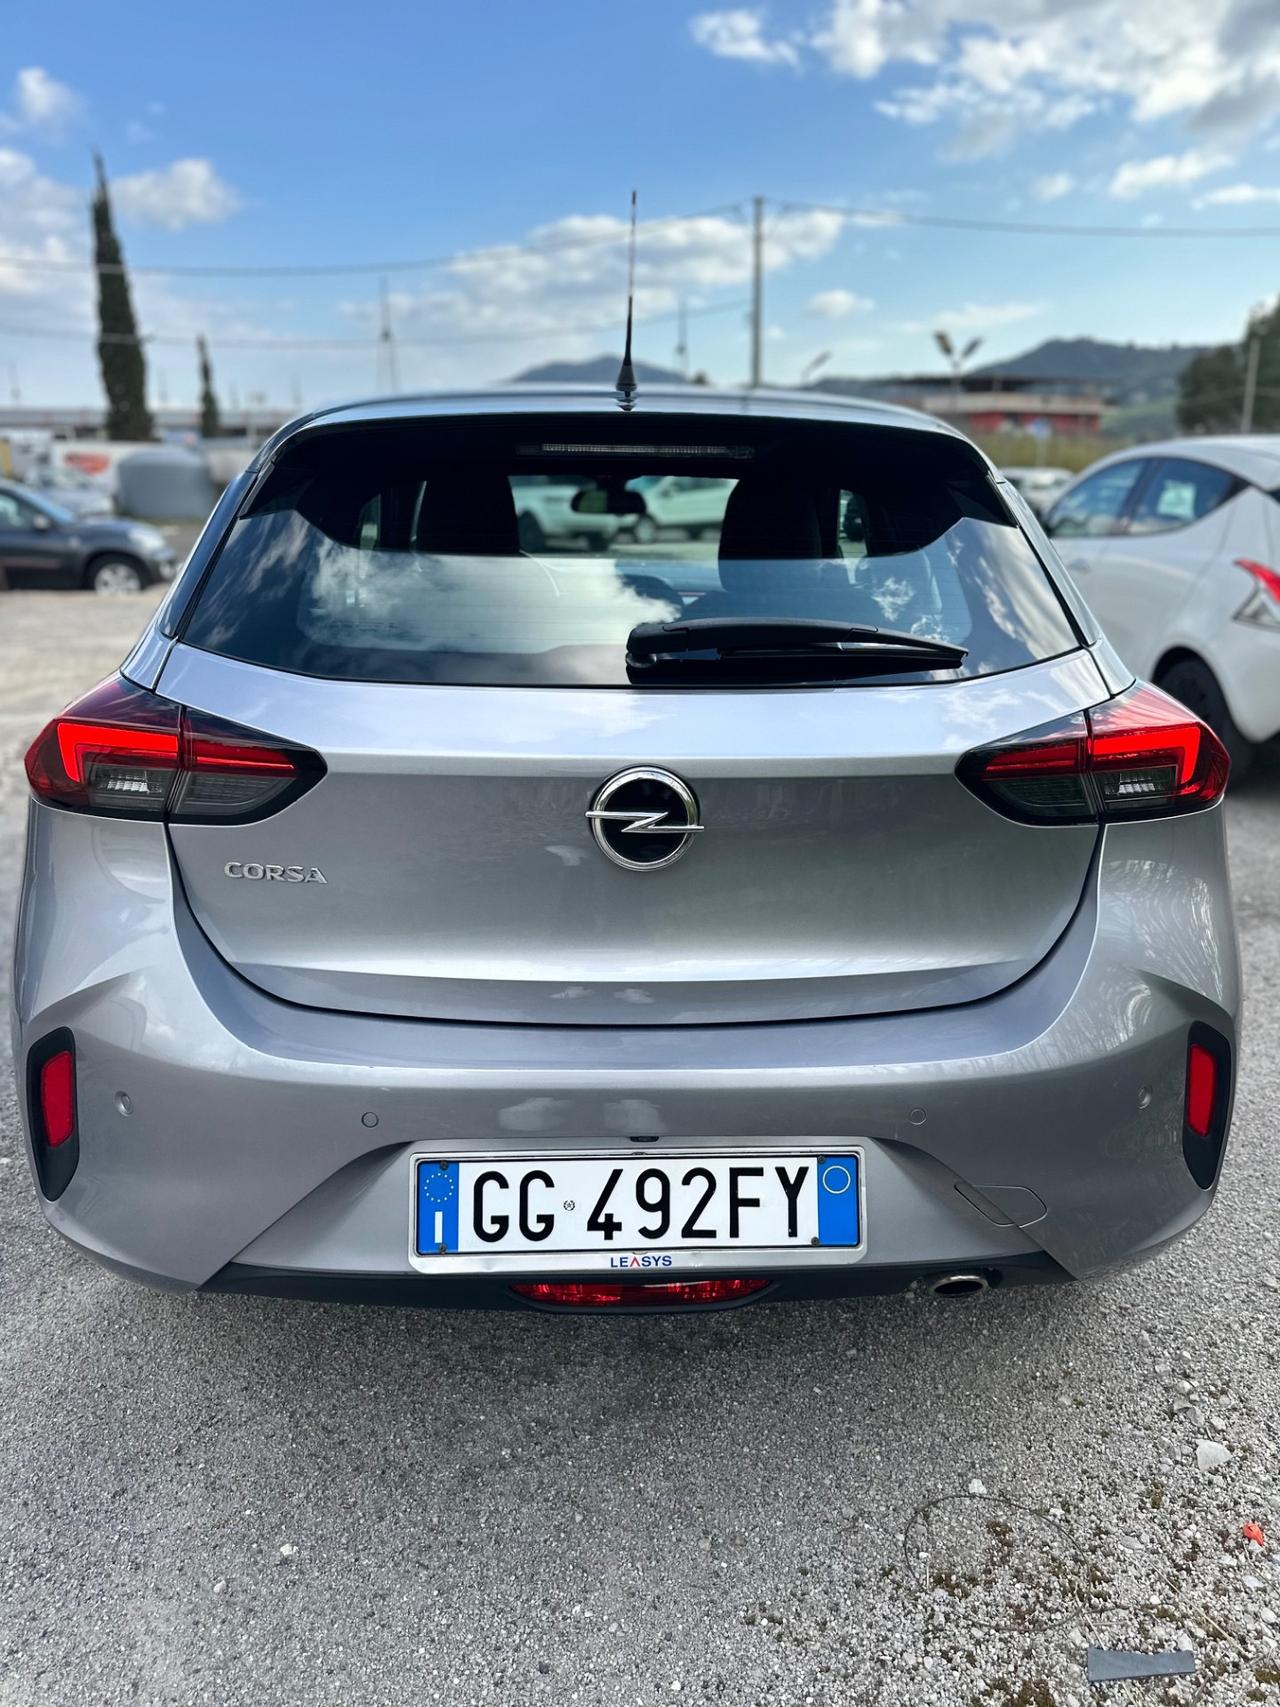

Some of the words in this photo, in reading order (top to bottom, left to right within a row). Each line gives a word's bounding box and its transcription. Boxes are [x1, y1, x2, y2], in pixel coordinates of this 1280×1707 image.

[224, 861, 328, 884] CORSA
[472, 1169, 555, 1243] GG
[586, 1166, 810, 1241] 492FY
[434, 1211, 443, 1243] I
[610, 1255, 672, 1268] LEASYS
